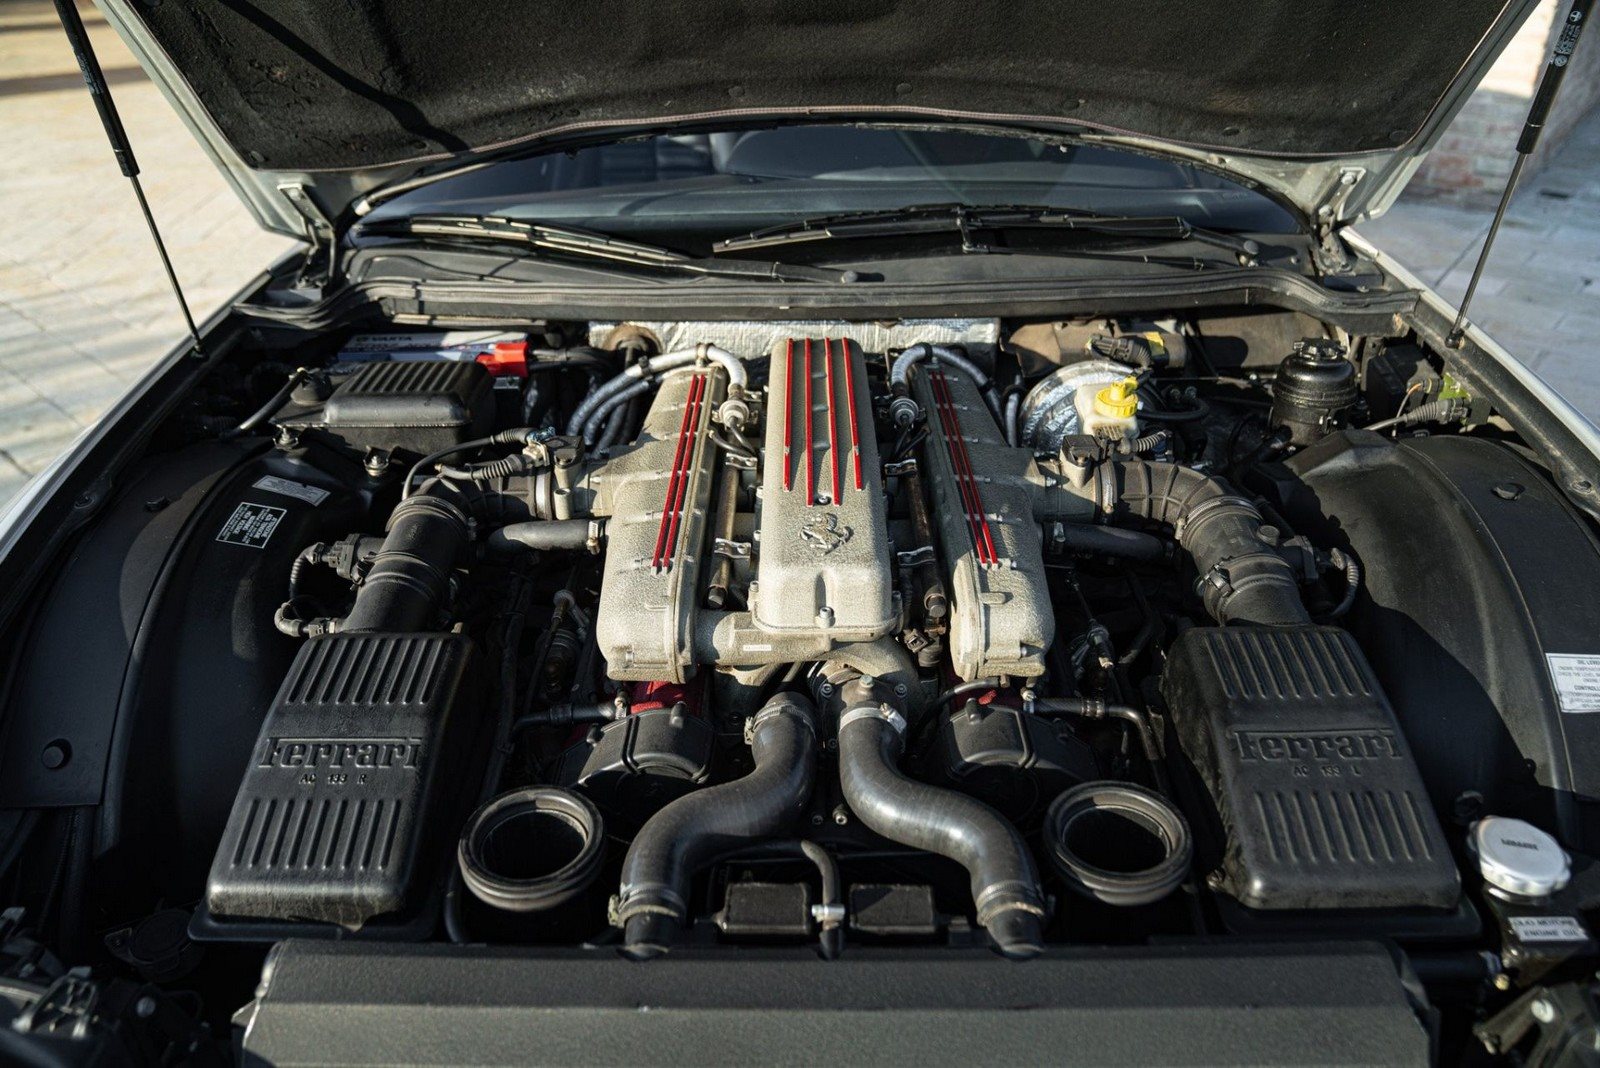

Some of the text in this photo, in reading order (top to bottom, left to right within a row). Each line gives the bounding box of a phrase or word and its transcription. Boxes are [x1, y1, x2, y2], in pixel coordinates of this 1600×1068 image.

[258, 736, 423, 769] Ferrari
[1232, 727, 1402, 762] Ferrari
[357, 773, 367, 785] R
